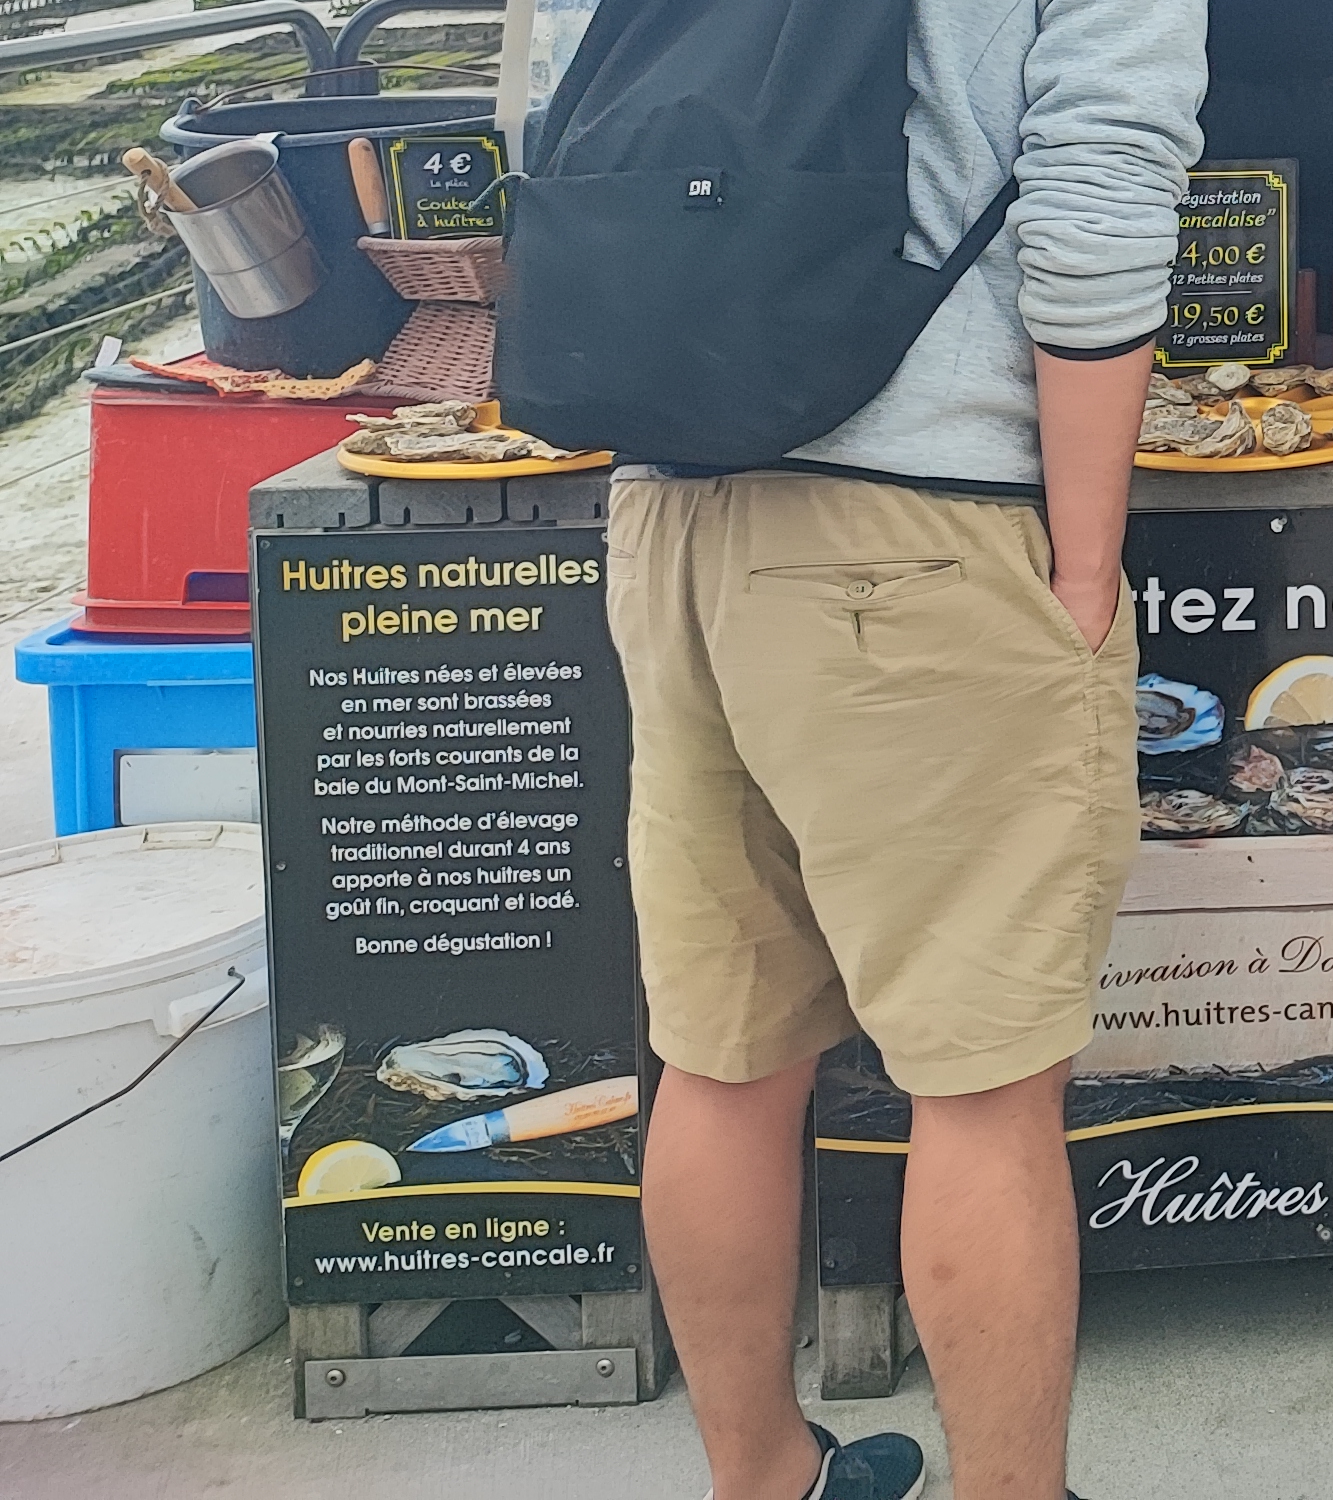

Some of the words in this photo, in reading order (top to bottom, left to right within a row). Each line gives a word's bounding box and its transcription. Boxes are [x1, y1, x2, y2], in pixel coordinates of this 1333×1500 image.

[417, 214, 428, 227] à
[434, 214, 494, 227] huîtres
[1170, 303, 1239, 331] 19,50
[1172, 334, 1185, 345] 12
[1186, 335, 1228, 347] grosses
[1230, 331, 1265, 345] plates
[282, 560, 408, 591] Huitres
[418, 554, 600, 588] naturelles
[1131, 575, 1256, 635] tez
[341, 604, 458, 642] pleine
[470, 606, 543, 633] mer
[309, 669, 347, 687] Nos
[352, 666, 420, 687] Huitres
[424, 665, 473, 684] nées
[478, 665, 499, 683] et
[503, 661, 582, 682] élevées
[314, 778, 360, 796] baie
[365, 776, 391, 795] du
[397, 771, 584, 794] Mont-Saint-Michel.
[356, 936, 418, 955] Bonne
[423, 931, 541, 956] dégustation
[1099, 956, 1238, 990] ivraison
[1248, 948, 1270, 973] à
[1089, 1156, 1328, 1230] Huîtres
[361, 1221, 436, 1243] Vente
[445, 1223, 477, 1240] en
[486, 1217, 550, 1242] ligne
[315, 1242, 615, 1275] www.huitres-cancale.fr
